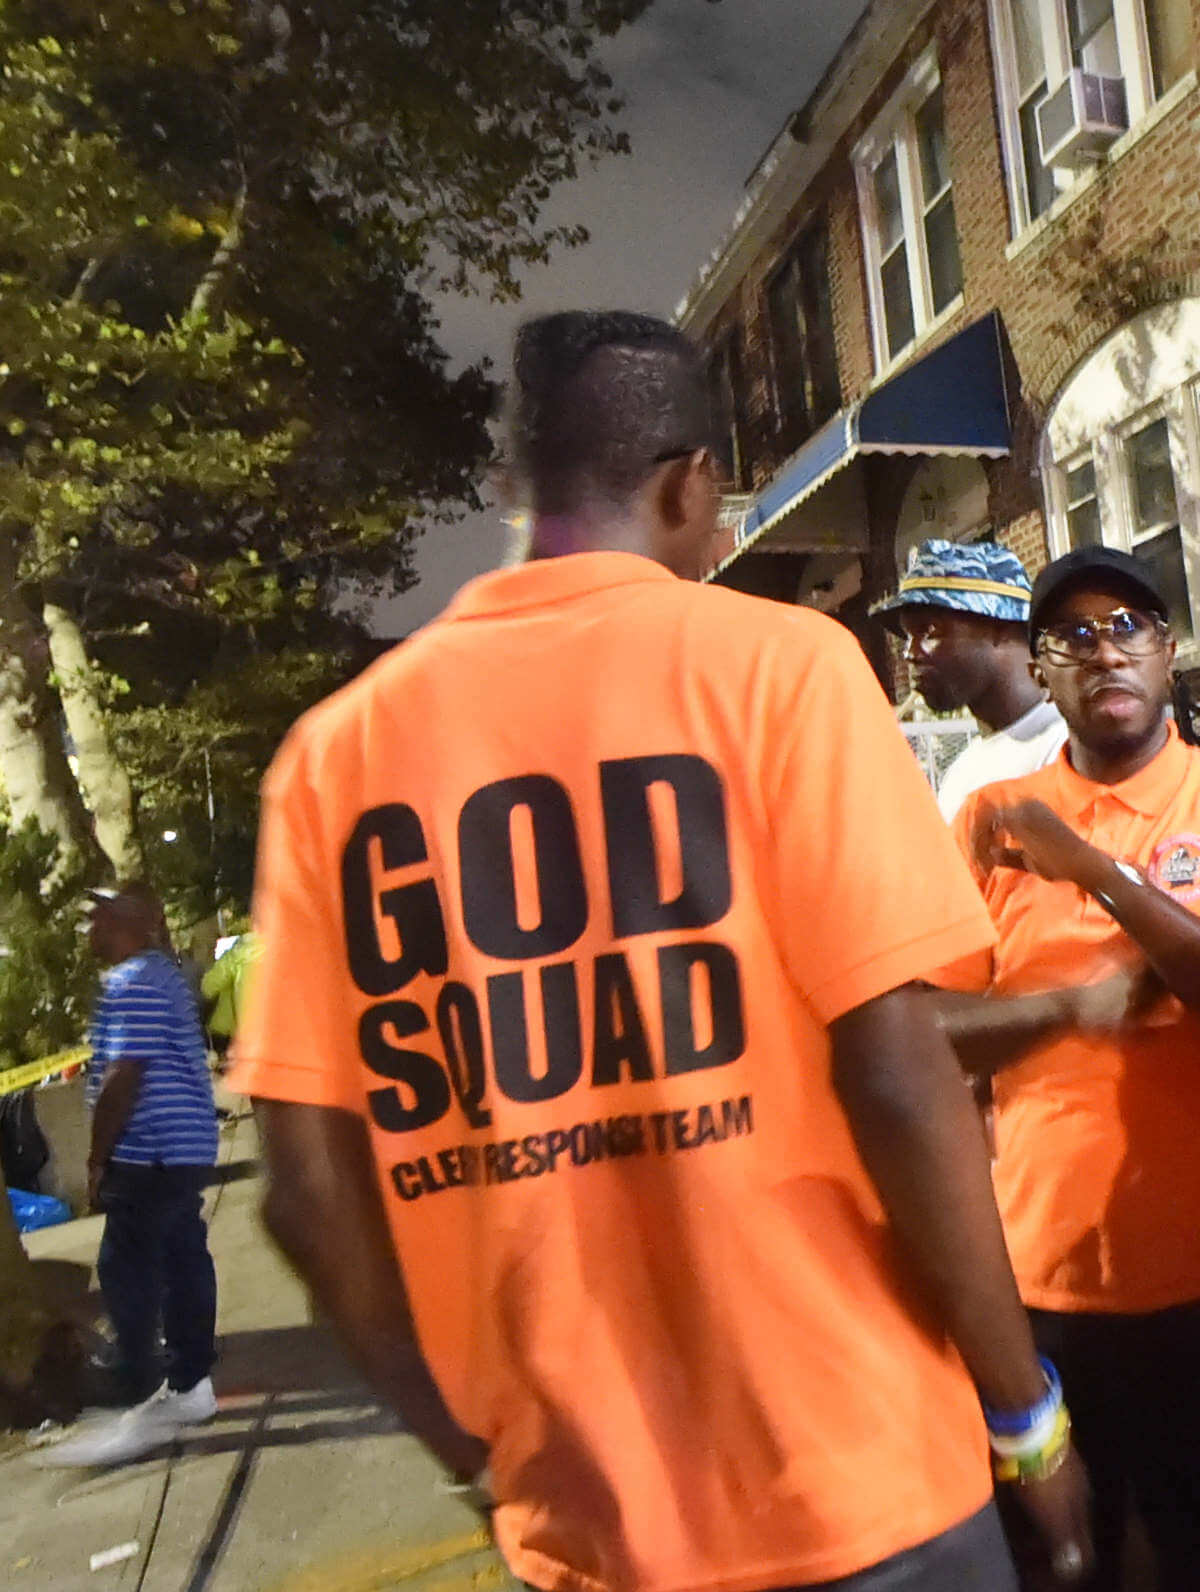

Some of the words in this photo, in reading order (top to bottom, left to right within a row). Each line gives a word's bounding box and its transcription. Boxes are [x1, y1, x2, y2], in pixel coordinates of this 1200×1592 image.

[341, 753, 732, 997] GOD
[357, 941, 747, 1134] SQUAD
[648, 1095, 754, 1156] TEAM
